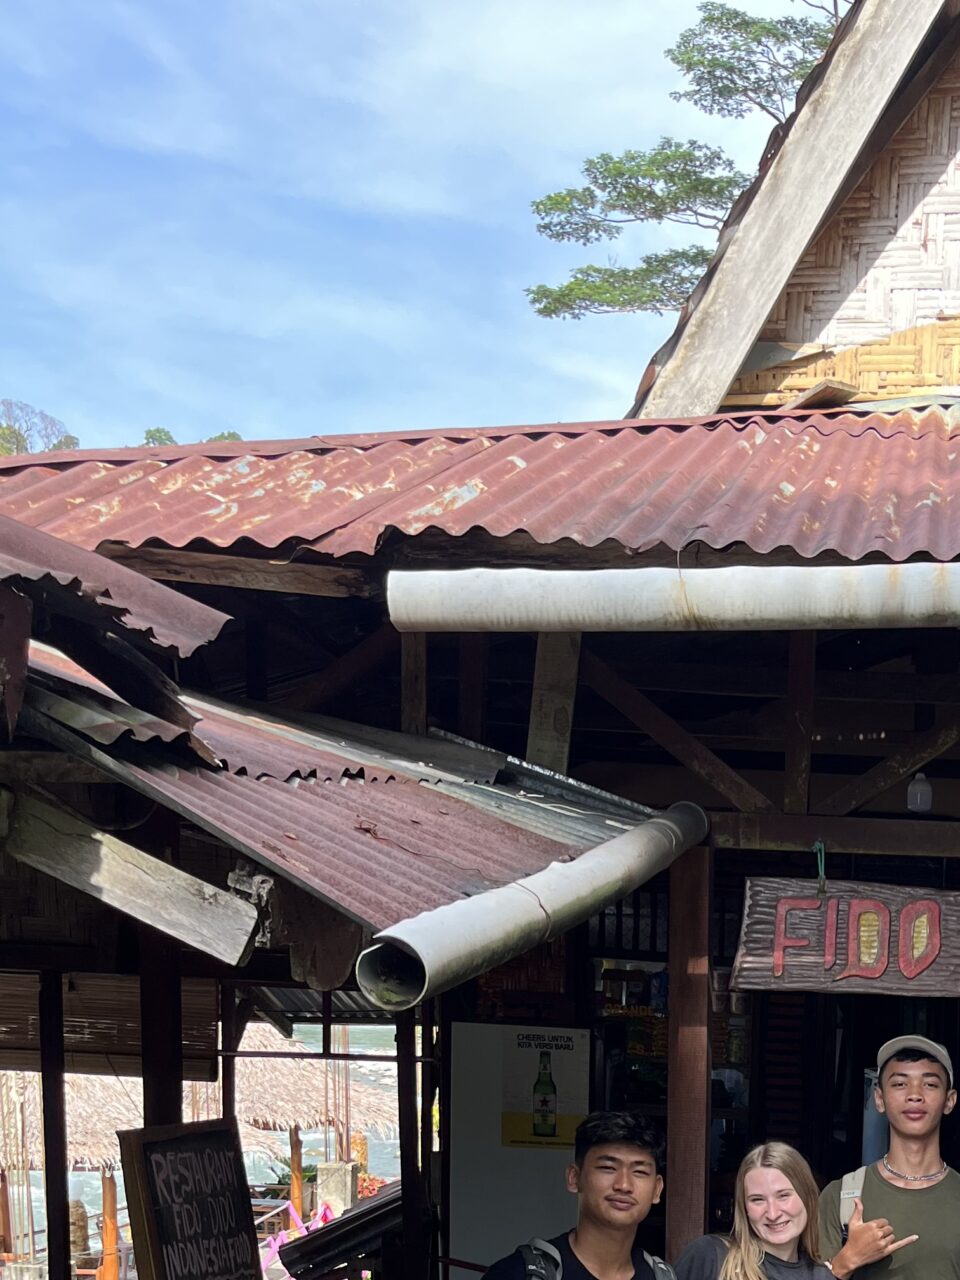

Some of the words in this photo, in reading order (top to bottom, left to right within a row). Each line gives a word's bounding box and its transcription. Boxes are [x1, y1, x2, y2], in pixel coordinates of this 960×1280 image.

[773, 899, 942, 982] FIDO
[517, 1033, 546, 1042] CHEERS
[548, 1035, 574, 1043] UNTUK
[517, 1041, 533, 1049] KITA
[150, 1148, 238, 1206] RESTAURANT
[172, 1200, 202, 1240] FIDO
[208, 1191, 235, 1235] DIDO
